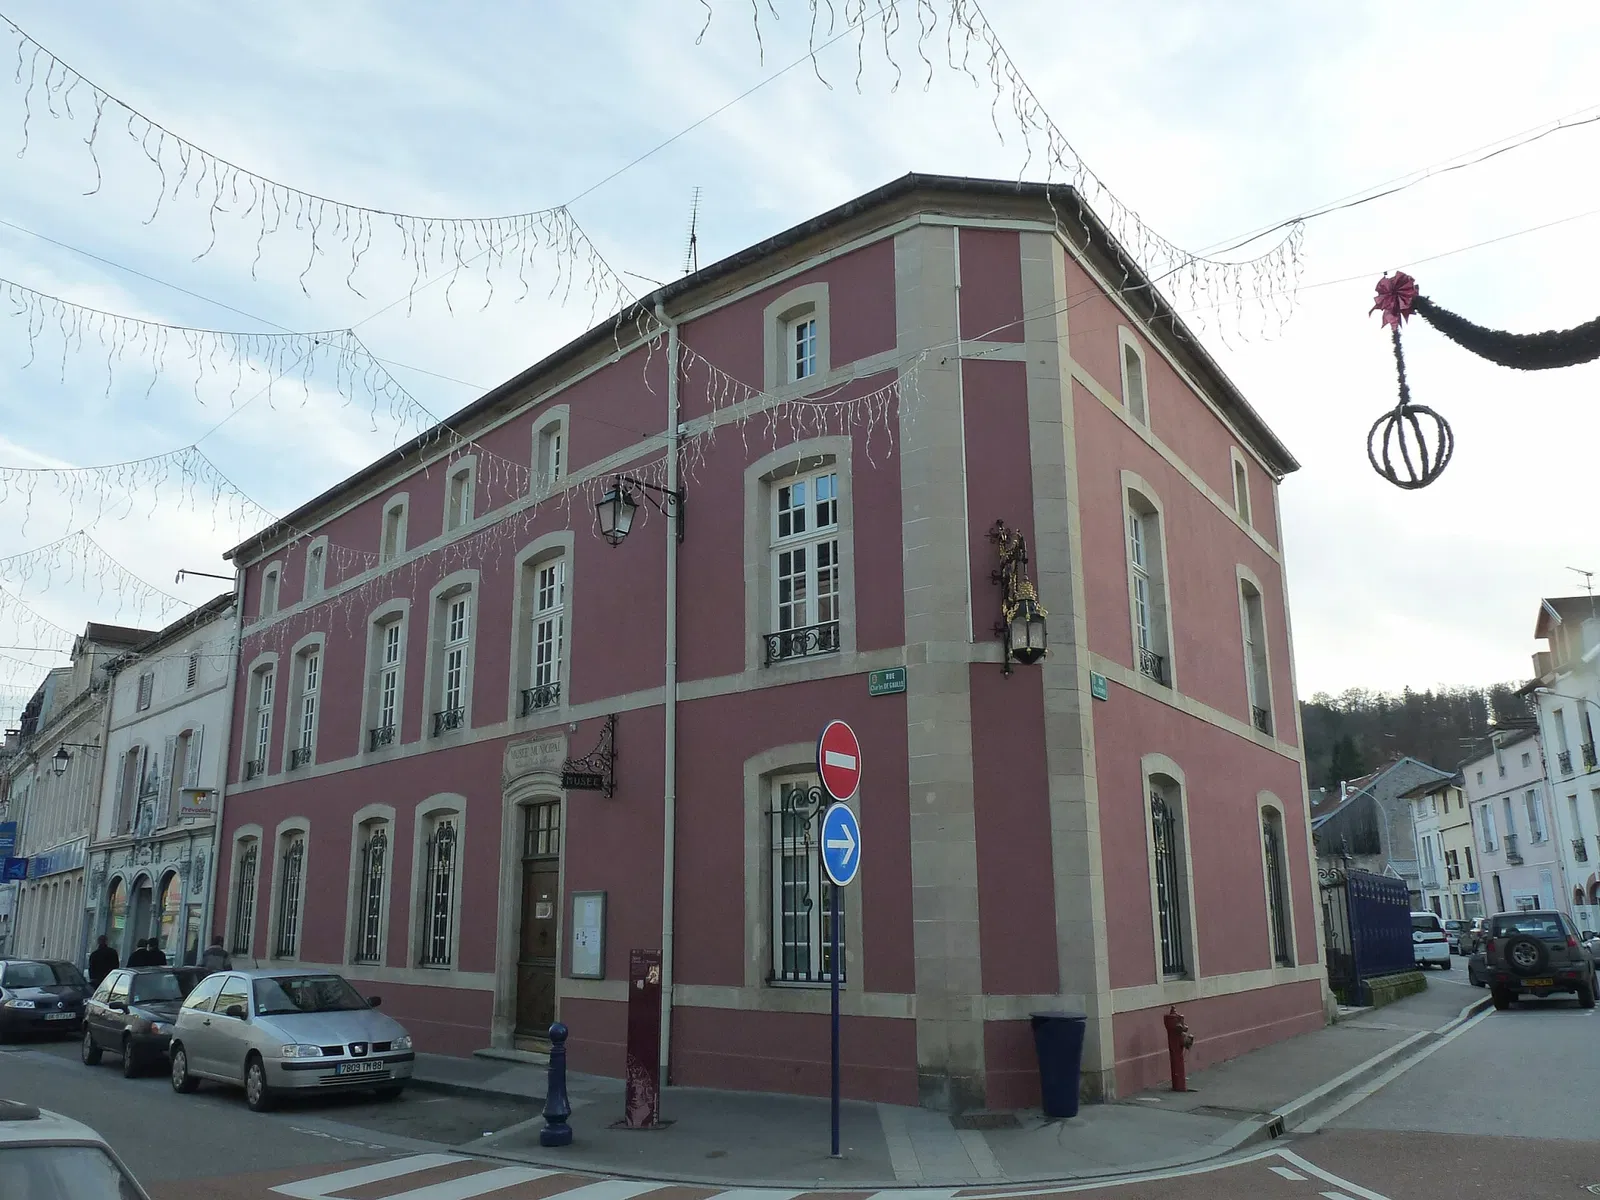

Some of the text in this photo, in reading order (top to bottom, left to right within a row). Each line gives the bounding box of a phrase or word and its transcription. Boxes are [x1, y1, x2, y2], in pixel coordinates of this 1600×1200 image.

[885, 672, 895, 680] RUE
[341, 1061, 382, 1073] 7809 TM 88
